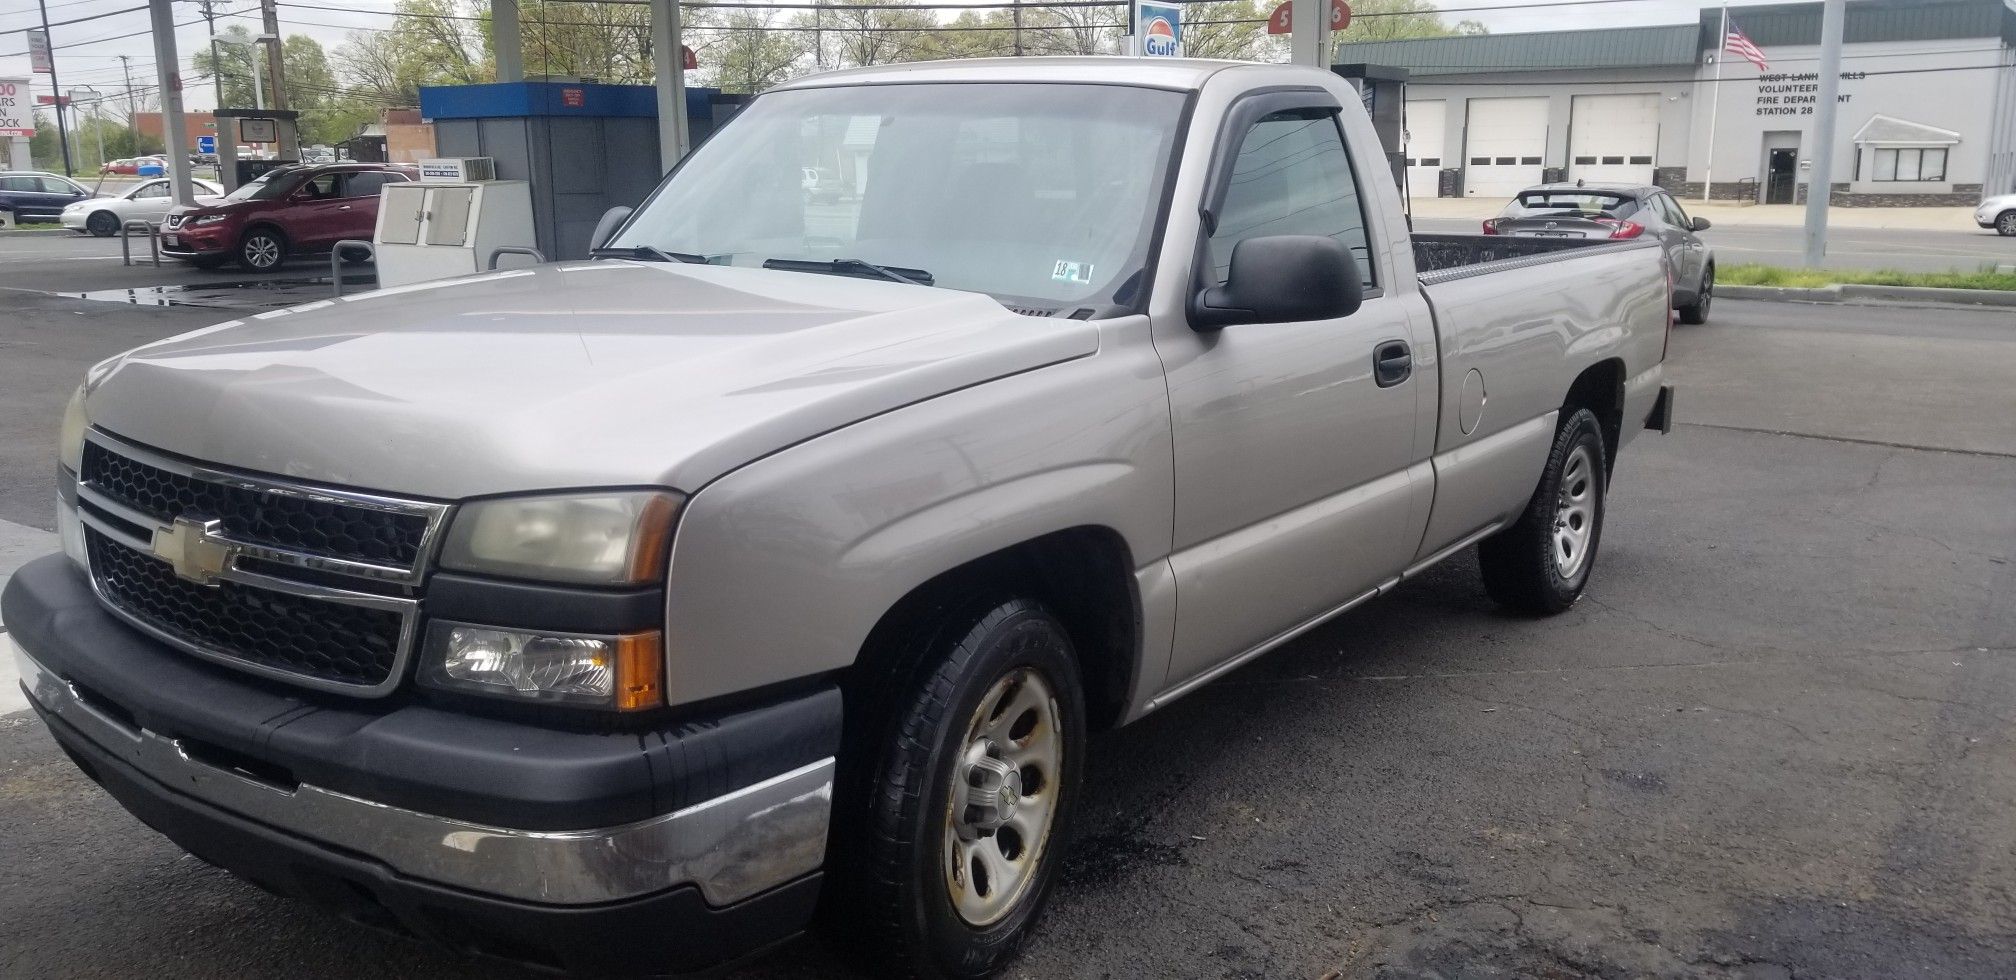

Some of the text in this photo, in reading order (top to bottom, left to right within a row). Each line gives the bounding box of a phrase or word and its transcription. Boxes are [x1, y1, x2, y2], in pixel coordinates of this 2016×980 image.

[1280, 10, 1289, 27] 5
[1331, 6, 1342, 23] 6
[1147, 37, 1176, 56] Gulf
[1758, 84, 1818, 94] VOLUNTEER
[1757, 96, 1779, 105] FIRE
[1756, 106, 1813, 116] STATION 28
[1055, 262, 1068, 276] 18
